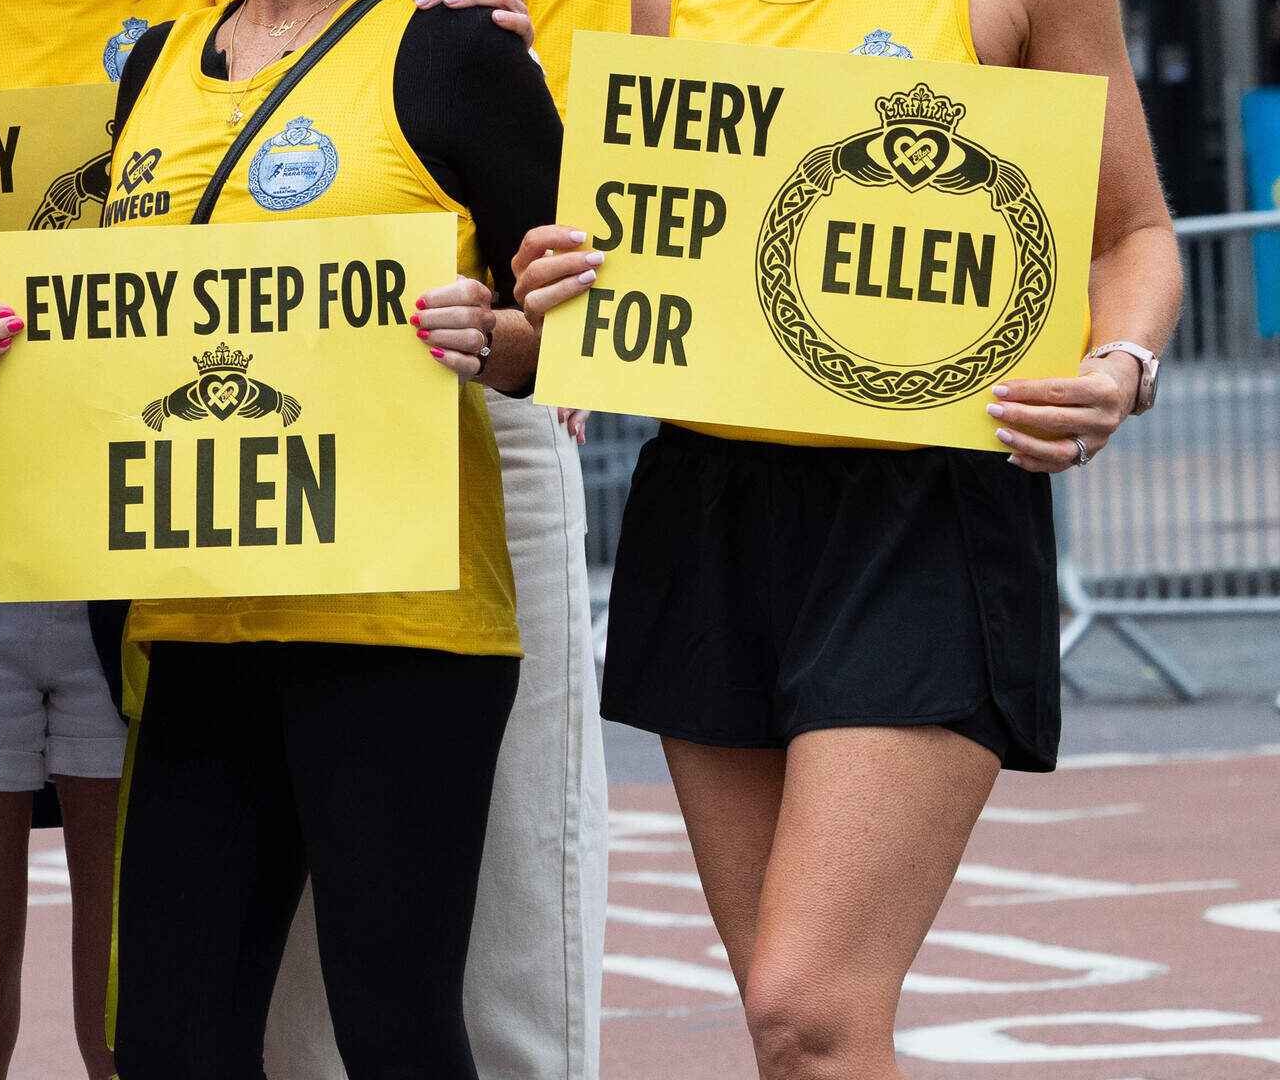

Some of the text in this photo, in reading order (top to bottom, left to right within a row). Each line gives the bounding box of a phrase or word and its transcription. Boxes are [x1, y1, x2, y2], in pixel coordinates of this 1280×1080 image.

[604, 74, 784, 156] EVERY
[592, 181, 726, 259] STEP
[26, 260, 407, 341] EVERY STEP FOR
[822, 221, 995, 307] ELLEN
[580, 287, 692, 366] FOR
[109, 434, 336, 550] ELLEN
